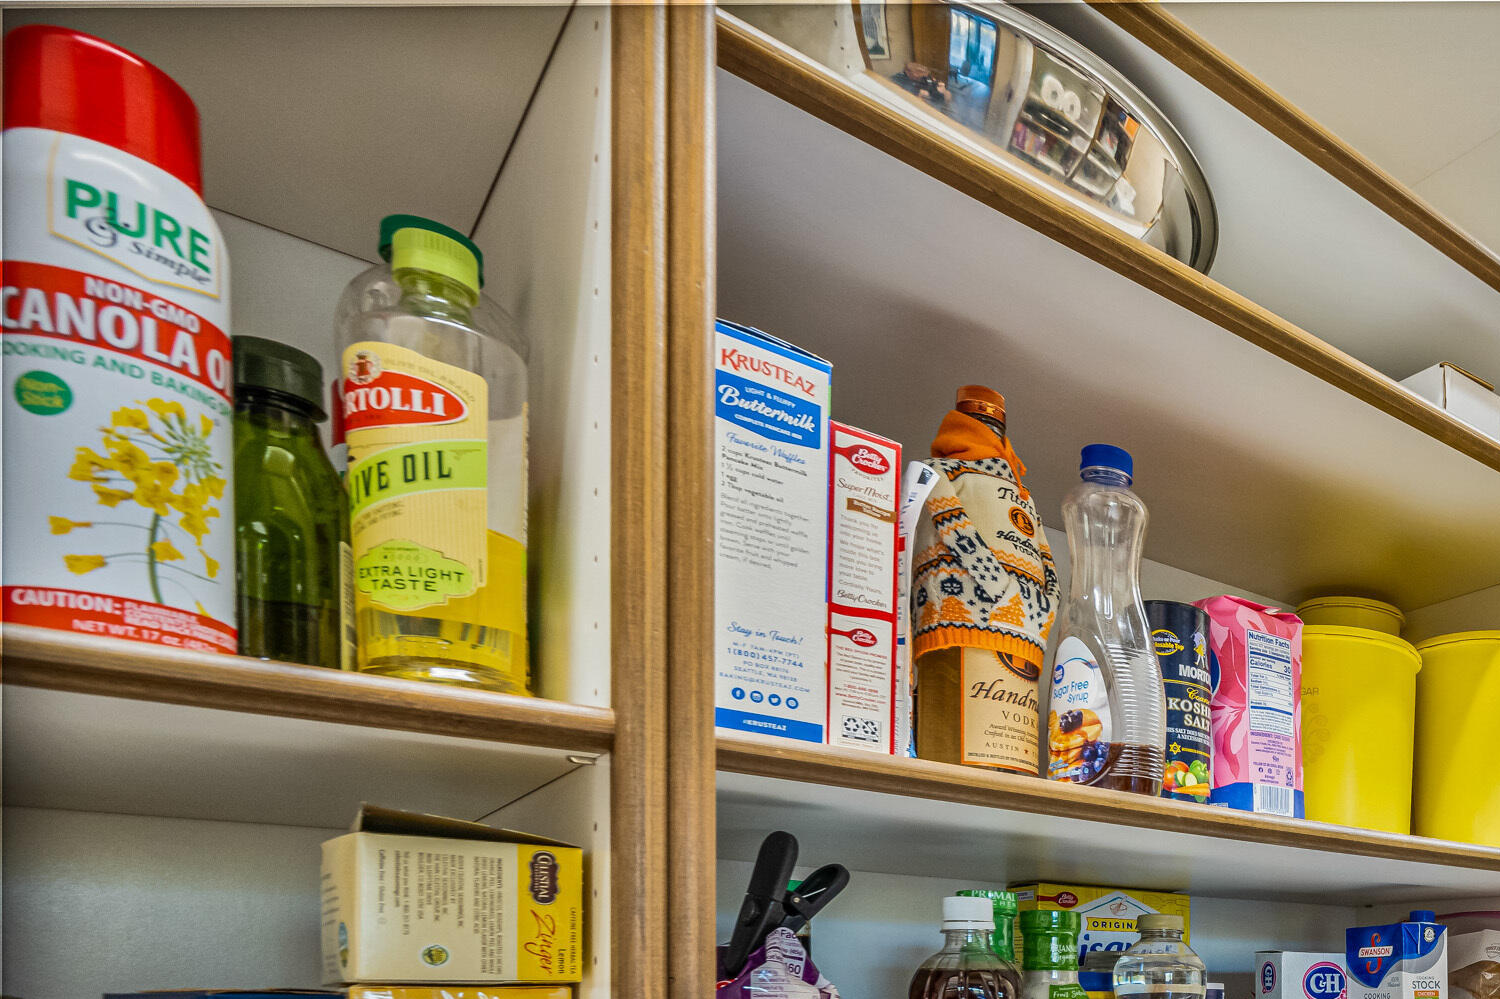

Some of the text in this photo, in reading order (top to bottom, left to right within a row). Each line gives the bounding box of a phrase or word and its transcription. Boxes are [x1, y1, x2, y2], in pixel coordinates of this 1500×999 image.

[64, 178, 212, 274] PURE
[84, 276, 200, 334] NON-GMO
[1, 284, 201, 377] CANOLA
[91, 355, 218, 410] AND BAKING
[720, 348, 816, 397] KRUSTEAZ
[344, 386, 447, 417] RTOLLI
[718, 384, 816, 433] Buttermilk
[403, 450, 452, 483] OIL
[851, 448, 888, 472] Betty Crocker
[359, 565, 465, 583] EXTRA LIGHT
[371, 578, 438, 592] TASTE
[11, 588, 122, 616] CAUTION:
[142, 628, 160, 641] 17
[727, 621, 752, 638] Stay
[1248, 632, 1290, 649] Nutrition Facts
[1070, 680, 1089, 691] Free
[1178, 663, 1211, 686] MORTO
[969, 679, 1039, 714] Handm
[1067, 692, 1089, 704] Syrup
[1184, 713, 1210, 732] SALT
[524, 909, 557, 976] Zinger
[1360, 948, 1392, 957] SWANSON
[558, 948, 566, 974] Lemon
[1310, 973, 1341, 994] C&H
[1412, 981, 1440, 990] STOCK
